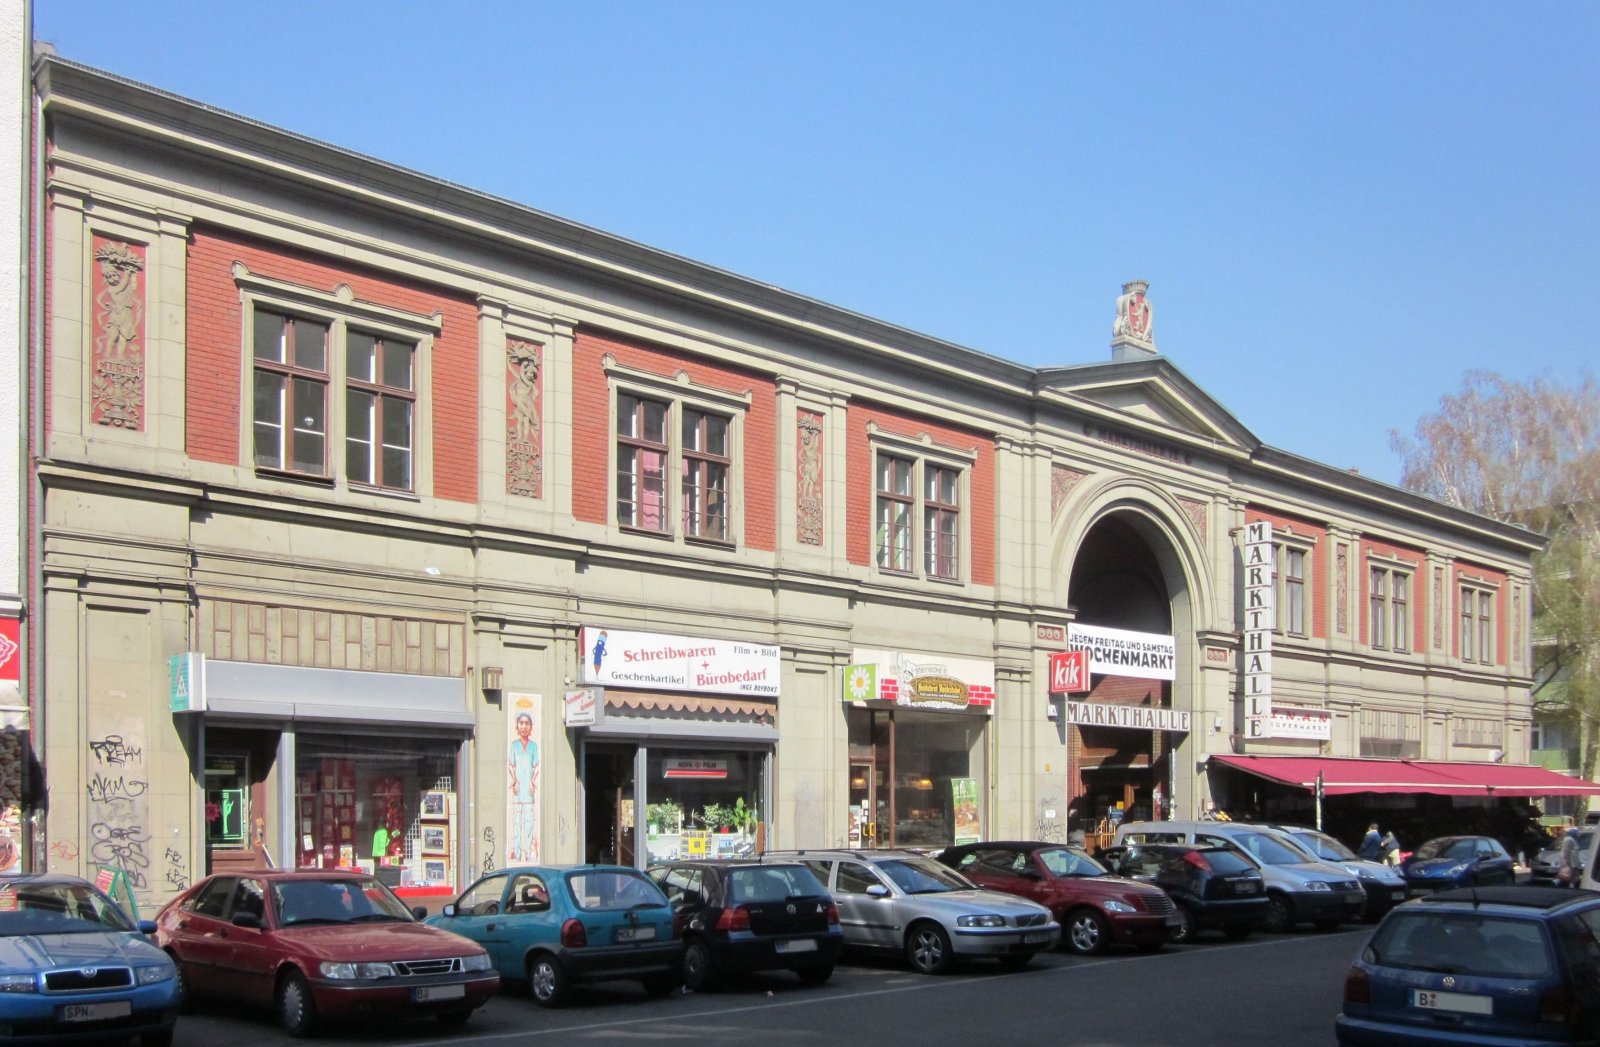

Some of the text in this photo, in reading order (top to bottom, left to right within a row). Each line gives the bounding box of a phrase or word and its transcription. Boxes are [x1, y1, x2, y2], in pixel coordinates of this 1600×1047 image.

[1249, 523, 1263, 738] MARKTHALLE
[733, 645, 751, 655] Film
[761, 648, 777, 657] Bild
[1070, 633, 1174, 654] JEDEN FREITAG UND SAMSTAG
[623, 646, 716, 663] Schreibwaren
[611, 671, 685, 685] Geschenkartikel
[696, 667, 767, 687] Bürobedarf
[1068, 703, 1188, 729] MARKTHALLE
[417, 989, 424, 999] B
[1419, 993, 1428, 1006] B
[66, 1006, 89, 1019] SPN
